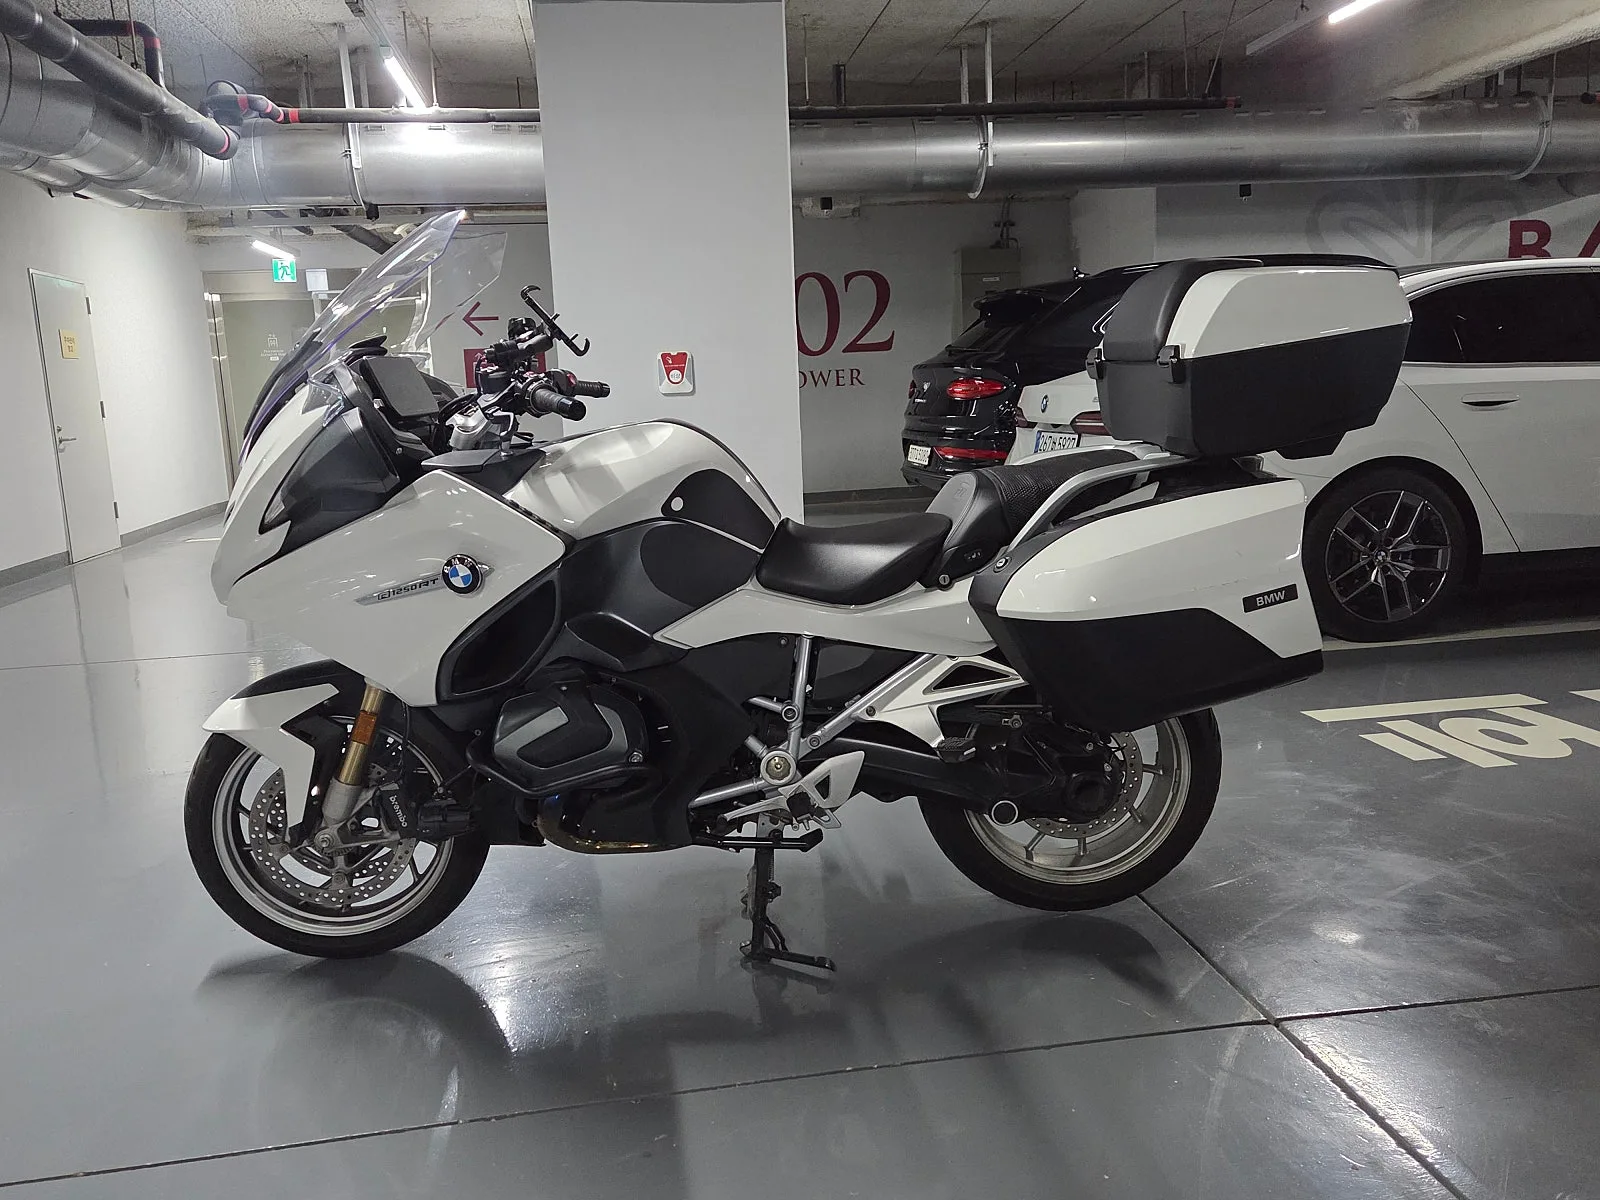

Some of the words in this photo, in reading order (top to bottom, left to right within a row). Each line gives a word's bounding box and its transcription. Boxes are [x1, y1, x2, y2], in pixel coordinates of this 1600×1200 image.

[795, 270, 895, 356] 02
[1255, 590, 1286, 607] BMW
[388, 795, 408, 827] brembo
